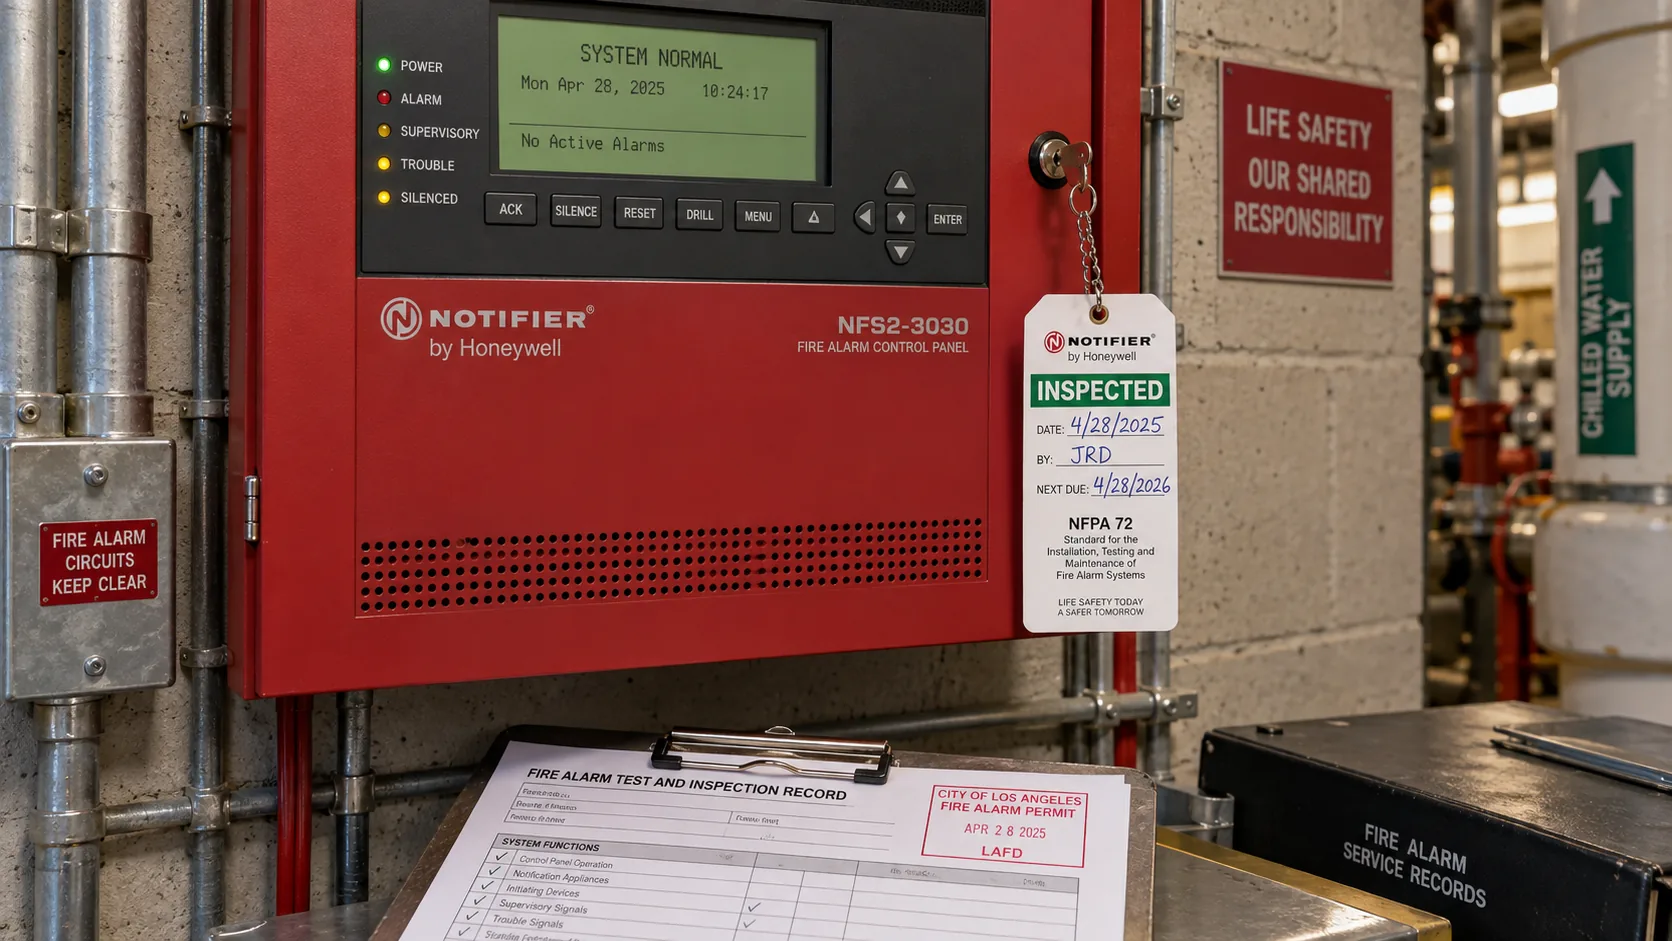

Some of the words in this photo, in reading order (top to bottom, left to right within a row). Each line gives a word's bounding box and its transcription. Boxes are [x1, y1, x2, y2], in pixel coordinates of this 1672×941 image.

[580, 44, 649, 66] SYSTEM
[658, 49, 723, 70] NORMAL
[401, 60, 443, 73] POWER
[521, 75, 549, 91] Mon
[558, 78, 585, 95] Apr
[594, 79, 619, 97] 28,
[630, 81, 665, 97] 2025
[702, 83, 769, 101] 10:24:17
[401, 93, 442, 105] ALARM
[401, 126, 480, 139] SUPERVISORY
[1246, 103, 1290, 140] LIFE
[1298, 110, 1372, 151] SAFETY
[521, 133, 540, 148] No
[549, 135, 604, 151] Active
[612, 136, 665, 153] Alarms
[401, 159, 455, 171] TROUBLE
[1248, 157, 1290, 192] OUR
[1296, 163, 1371, 200] SHARED
[401, 192, 458, 204] SILENCED
[499, 203, 523, 215] ACK
[555, 203, 598, 218] SILENCE
[624, 206, 656, 220] RESET
[686, 207, 714, 222] DRILL
[744, 209, 773, 223] MENU
[934, 213, 963, 226] ENTER
[1234, 201, 1384, 244] RESPONSIBILITY
[1581, 246, 1603, 337] WATER
[838, 316, 969, 335] NFS2-3030
[429, 339, 453, 360] by
[459, 338, 562, 361] Honeywell
[797, 341, 823, 353] FIRE
[827, 341, 870, 353] ALARM
[873, 341, 929, 353] CONTROL
[932, 341, 969, 353] PANEL
[1606, 297, 1631, 399] SUPPLY
[1068, 352, 1080, 363] by
[1083, 352, 1136, 363] Honeywell
[1037, 380, 1163, 401] INSPECTED
[1581, 342, 1604, 439] CHILLED
[1037, 425, 1065, 435] DATE:
[1071, 411, 1164, 439] 4/28/2025
[1037, 455, 1053, 465] BY:
[1071, 446, 1112, 464] JRD
[1037, 485, 1063, 494] NEXT
[1066, 485, 1090, 494] DUE:
[1093, 472, 1171, 499] 4/28/2026
[1069, 517, 1111, 530] NFPA
[1115, 517, 1133, 530] 72
[52, 531, 87, 549] FIRE
[93, 529, 147, 547] ALARM
[1064, 535, 1105, 544] Standard
[1108, 535, 1121, 544] for
[1123, 535, 1138, 544] the
[1047, 547, 1099, 557] Installation,
[1101, 547, 1135, 558] Testing
[1137, 547, 1155, 556] and
[65, 552, 135, 570] CIRCUITS
[1065, 559, 1124, 568] Maintenance
[1127, 559, 1137, 568] of
[1056, 571, 1074, 580] Fire
[1076, 571, 1104, 580] Alarm
[1106, 570, 1145, 581] Systems
[52, 576, 92, 595] KEEP
[98, 573, 147, 593] CLEAR
[1058, 598, 1076, 606] LIFE
[1079, 598, 1112, 606] SAFETY
[1114, 598, 1144, 606] TODAY
[1057, 608, 1064, 616] A
[1065, 608, 1092, 616] SAFER
[1094, 608, 1144, 616] TOMORROW
[527, 768, 560, 780] FIRE
[561, 771, 613, 784] ALARM
[616, 774, 653, 787] TEST
[654, 777, 686, 789] AND
[689, 779, 779, 796] INSPECTION
[783, 786, 847, 801] RECORD
[938, 789, 967, 799] CITY
[970, 791, 988, 801] OF
[991, 792, 1017, 802] LOS
[1021, 794, 1082, 806] ANGELES
[940, 801, 970, 812] FIRE
[974, 803, 1021, 815] ALARM
[1025, 806, 1076, 818] PERMIT
[964, 823, 988, 835] APR
[1019, 826, 1046, 839] 2025
[501, 838, 541, 848] SYSTEM
[543, 840, 600, 852] FUNCTIONS
[981, 846, 1023, 859] LAFD
[1365, 823, 1399, 852] FIRE
[1407, 837, 1467, 875] ALARM
[519, 855, 549, 865] Control
[550, 857, 572, 867] Panel
[574, 859, 613, 870] Operation
[513, 870, 561, 881] Notification
[562, 873, 609, 884] Appliances
[1343, 841, 1404, 879] SERVICE
[1410, 864, 1487, 909] RECORDS
[506, 884, 544, 896] Initiating
[545, 887, 580, 898] Devices
[499, 899, 552, 913] Supervisory
[554, 903, 588, 915] Signals
[493, 914, 527, 926] Trouble
[529, 916, 564, 929] Signals
